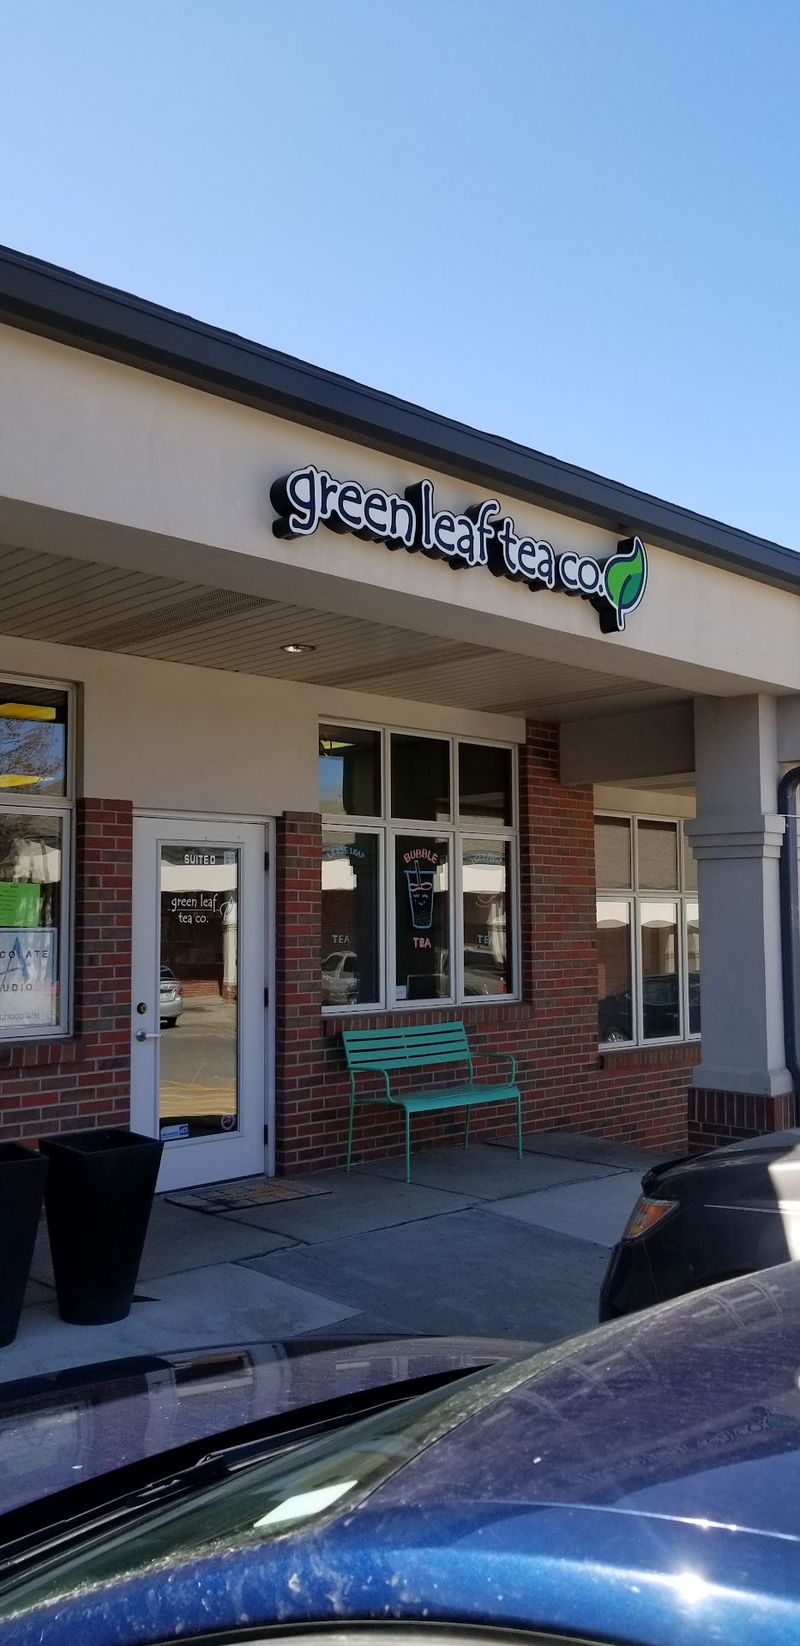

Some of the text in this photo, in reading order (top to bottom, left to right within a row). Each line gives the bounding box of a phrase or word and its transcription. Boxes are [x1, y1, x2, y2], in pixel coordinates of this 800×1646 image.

[287, 465, 605, 596] green leaf tea co.
[403, 848, 439, 864] BUBBLE
[171, 893, 219, 913] green leaf
[178, 912, 209, 924] tea co.
[331, 934, 350, 944] TEA
[412, 936, 432, 949] TEA
